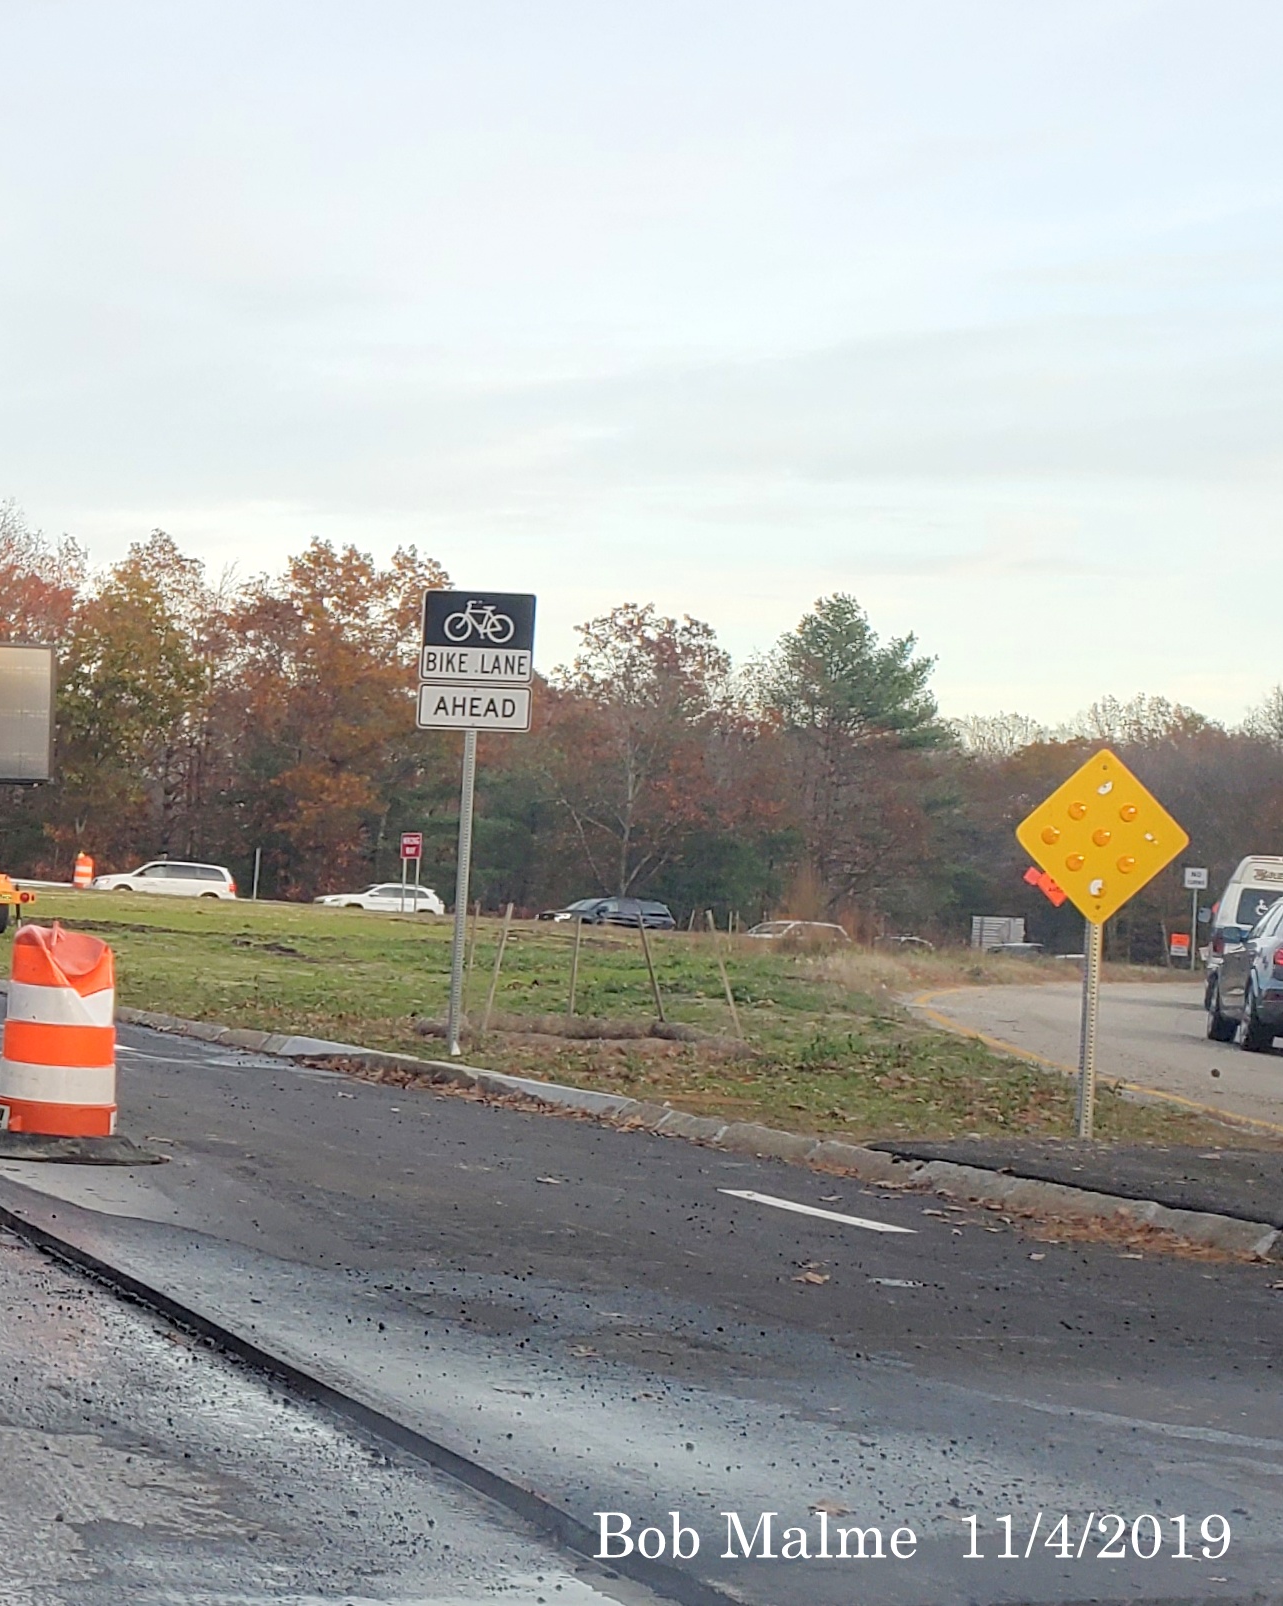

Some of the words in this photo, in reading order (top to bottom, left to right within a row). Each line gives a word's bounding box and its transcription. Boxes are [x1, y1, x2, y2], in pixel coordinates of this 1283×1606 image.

[425, 651, 469, 673] BIKE
[480, 653, 528, 676] LANE
[432, 696, 517, 718] AHEAD
